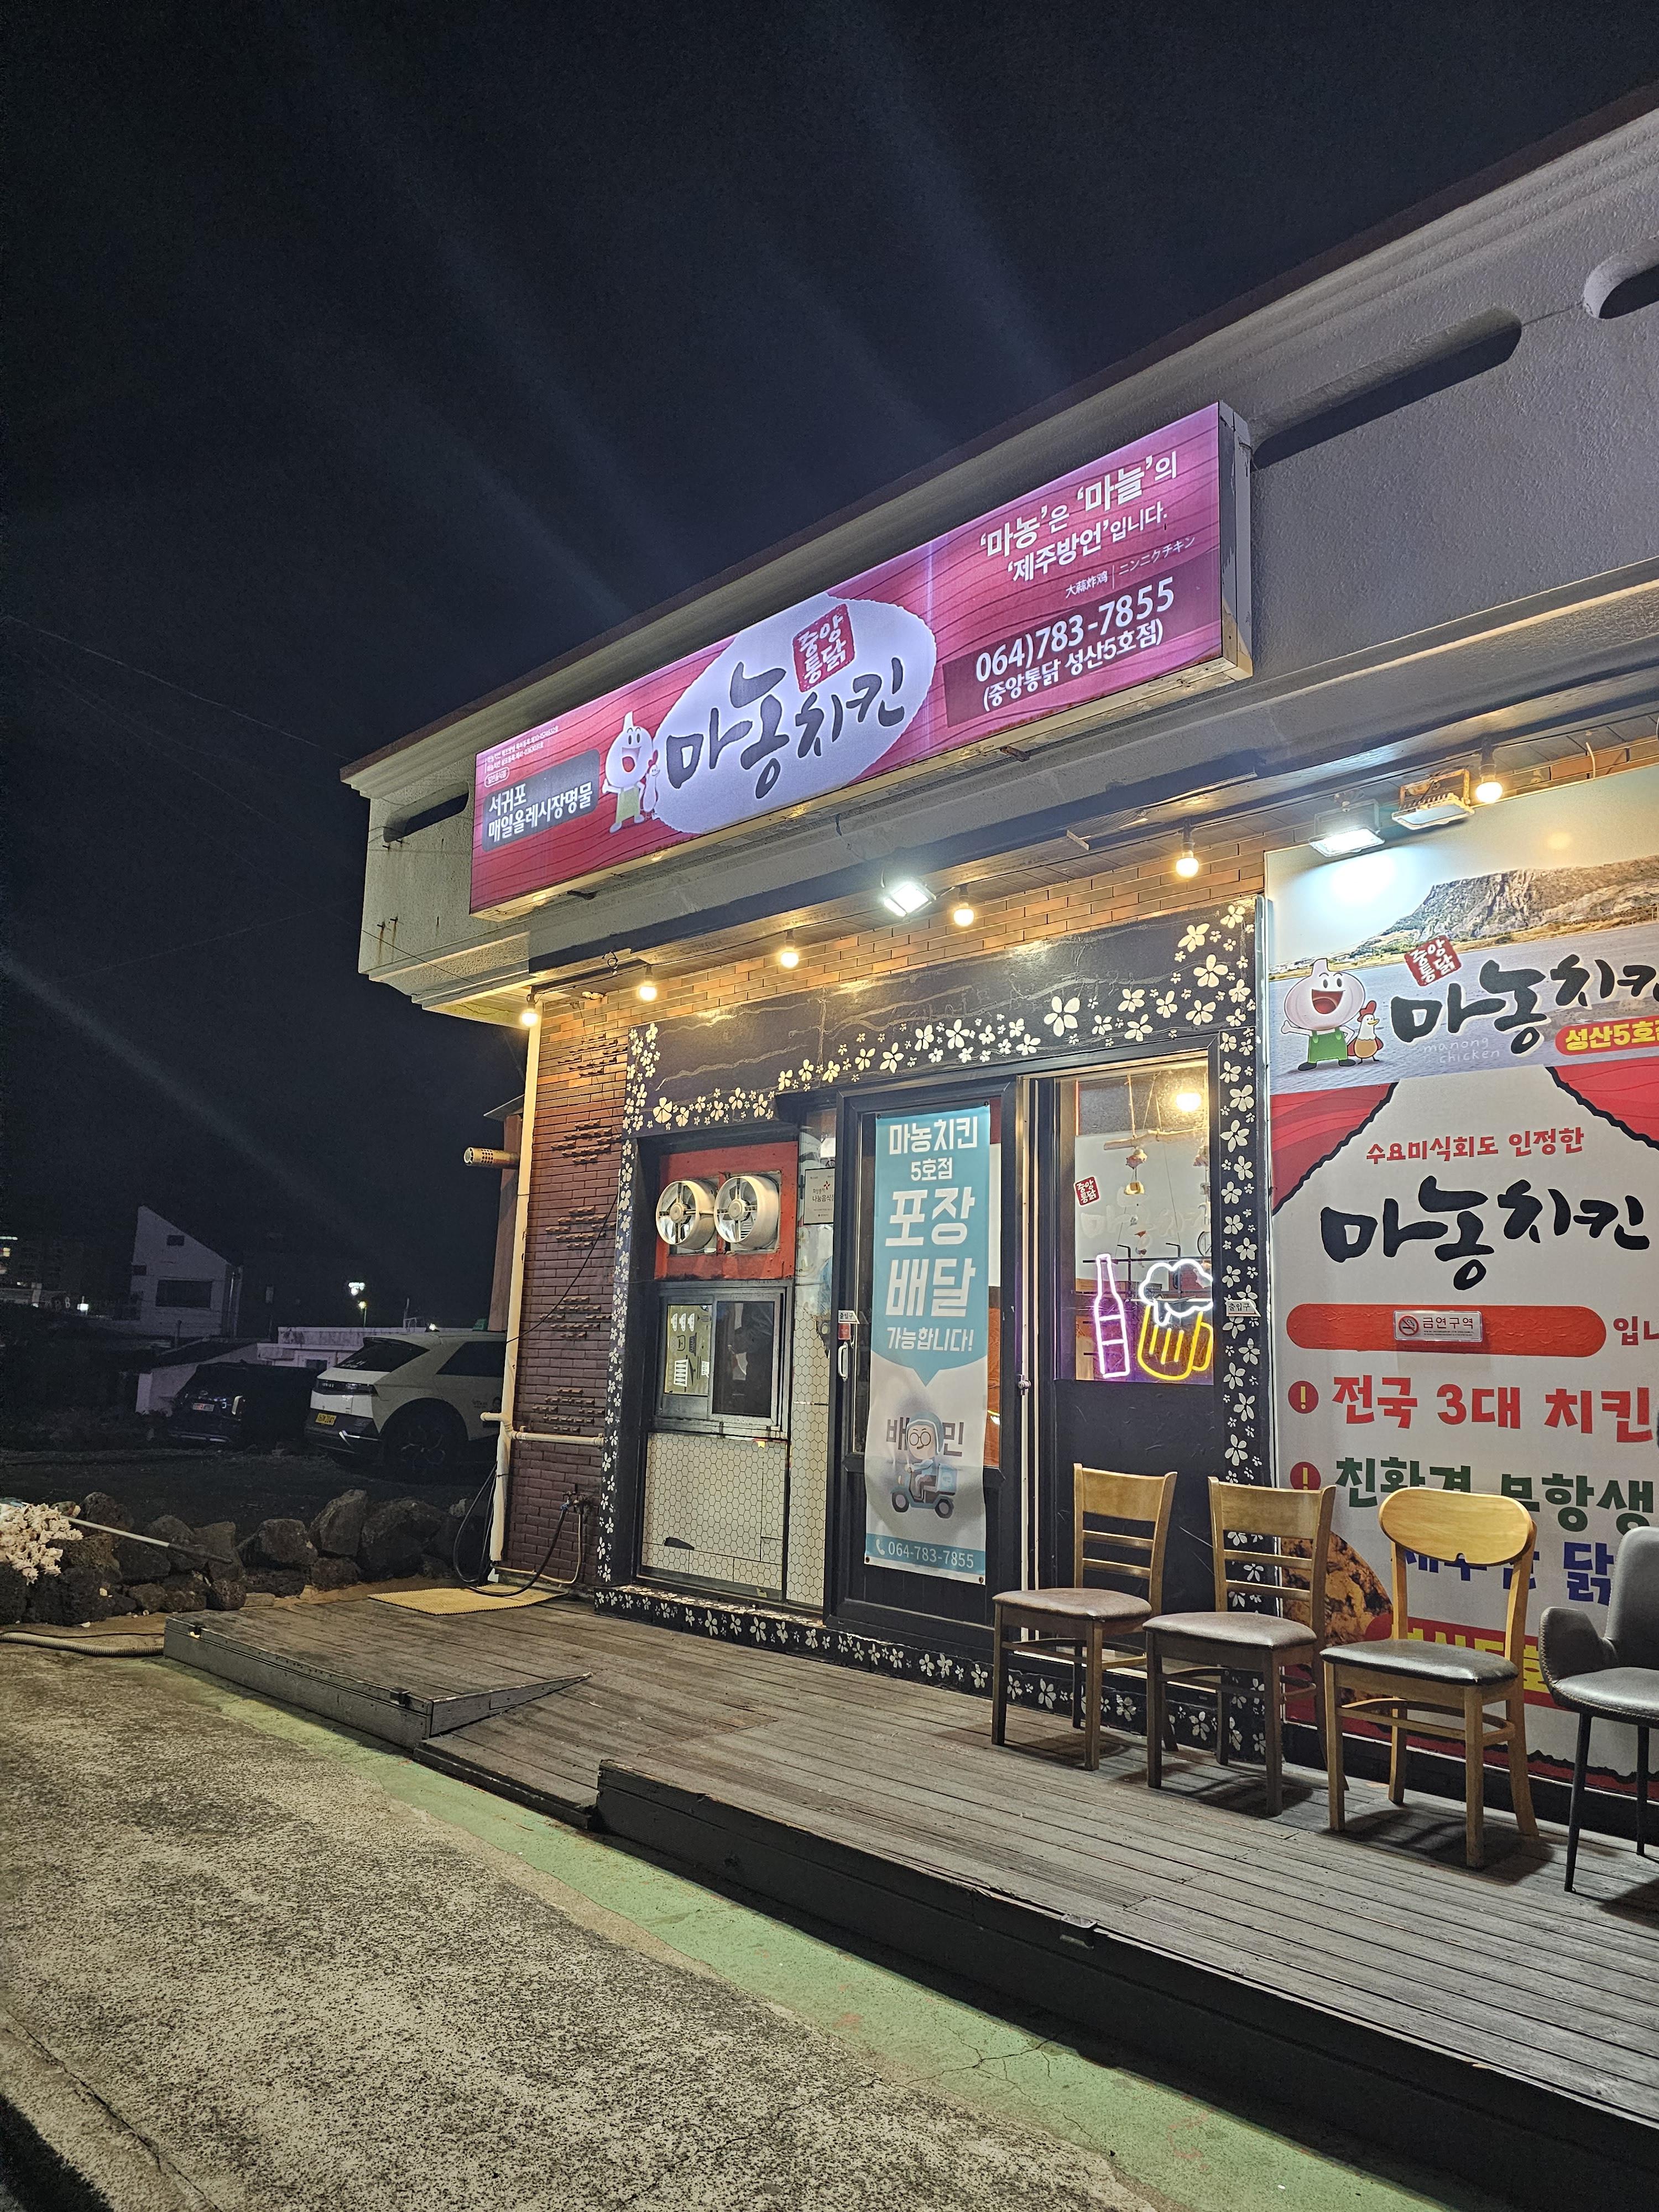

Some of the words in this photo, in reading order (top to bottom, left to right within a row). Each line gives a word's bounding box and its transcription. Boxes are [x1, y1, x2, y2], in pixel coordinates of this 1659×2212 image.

[1119, 536, 1195, 575] ニンニクチキン
[797, 615, 843, 658] 중앙
[976, 576, 1175, 682] 064)783-7855
[804, 639, 847, 684] 통닭
[983, 659, 1061, 712] (중앙통닭
[1065, 618, 1163, 676] 성산5호점)
[666, 657, 904, 799] 마농치킨
[488, 781, 593, 842] 매일올레시장명물
[489, 783, 526, 816] 서귀포
[1410, 939, 1446, 967] 중앙
[1418, 954, 1455, 983] 통닭
[1423, 1038, 1488, 1052] manong
[1566, 1020, 1659, 1051] 성산5호
[1440, 1050, 1499, 1063] chicken
[889, 1116, 978, 1155] 마농치킨
[1366, 1135, 1499, 1164] 수요미식회도
[1509, 1126, 1584, 1156] 인정한
[910, 1157, 953, 1181] 5호점
[1077, 1180, 1094, 1193] 중앙
[1081, 1188, 1097, 1203] 통닭
[885, 1186, 975, 1246] 포장
[1321, 1176, 1650, 1290] 마농치킨
[885, 1258, 976, 1317] 배달
[1229, 1303, 1250, 1311] 출입구
[1423, 1317, 1473, 1329] 금연구역
[886, 1327, 974, 1352] 가능합니다!
[1332, 1375, 1417, 1429] 전국
[1437, 1384, 1520, 1430] 3대
[1544, 1387, 1653, 1443] 치킨
[888, 1541, 973, 1568] 064-783-7855
